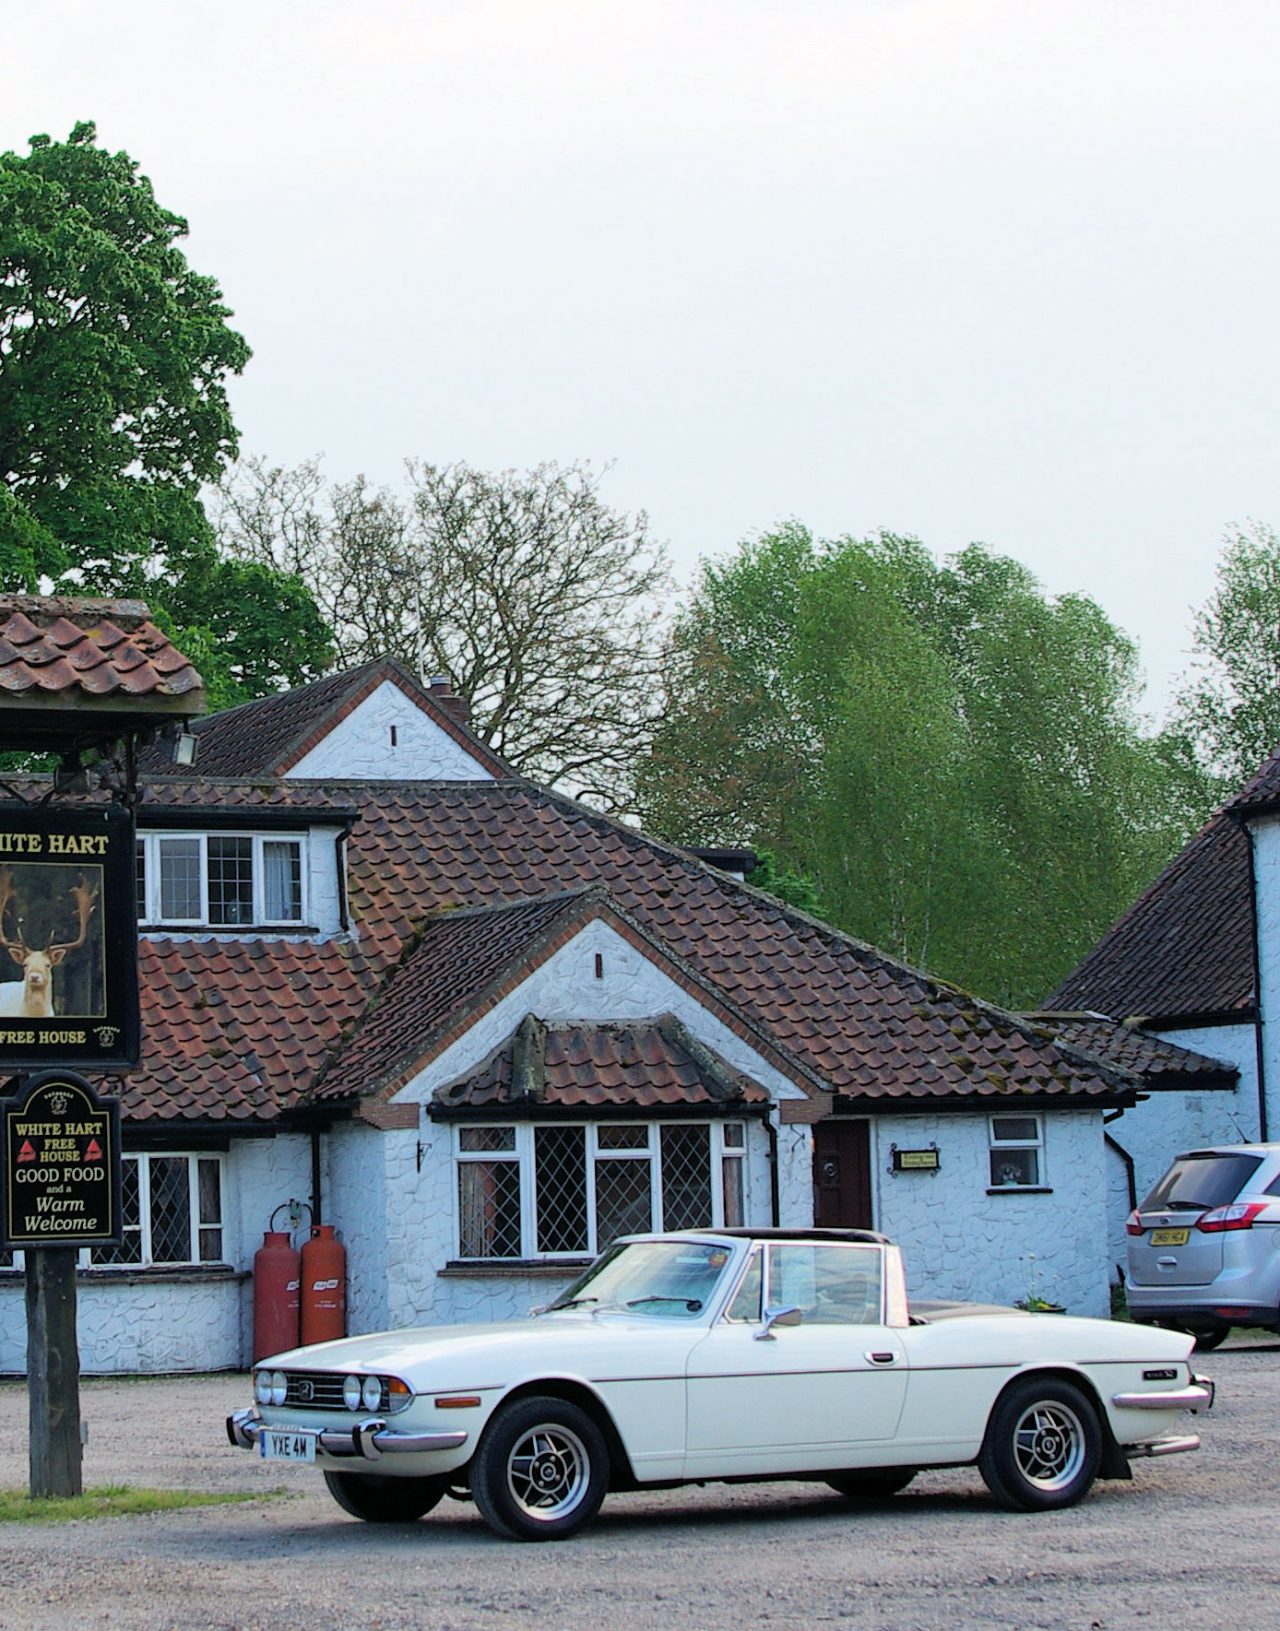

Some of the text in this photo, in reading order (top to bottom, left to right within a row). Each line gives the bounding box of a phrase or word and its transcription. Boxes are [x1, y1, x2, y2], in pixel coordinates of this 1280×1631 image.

[48, 835, 109, 854] HART
[39, 1031, 86, 1044] HOUSE
[16, 1123, 103, 1136] WHITE HART
[44, 1139, 76, 1150] FREE
[40, 1151, 80, 1162] HOUSE
[16, 1167, 104, 1183] GOOD FOOD
[46, 1185, 72, 1193] and a
[36, 1197, 85, 1212] Warm
[25, 1216, 97, 1231] Welcome
[272, 1435, 290, 1456] YXE
